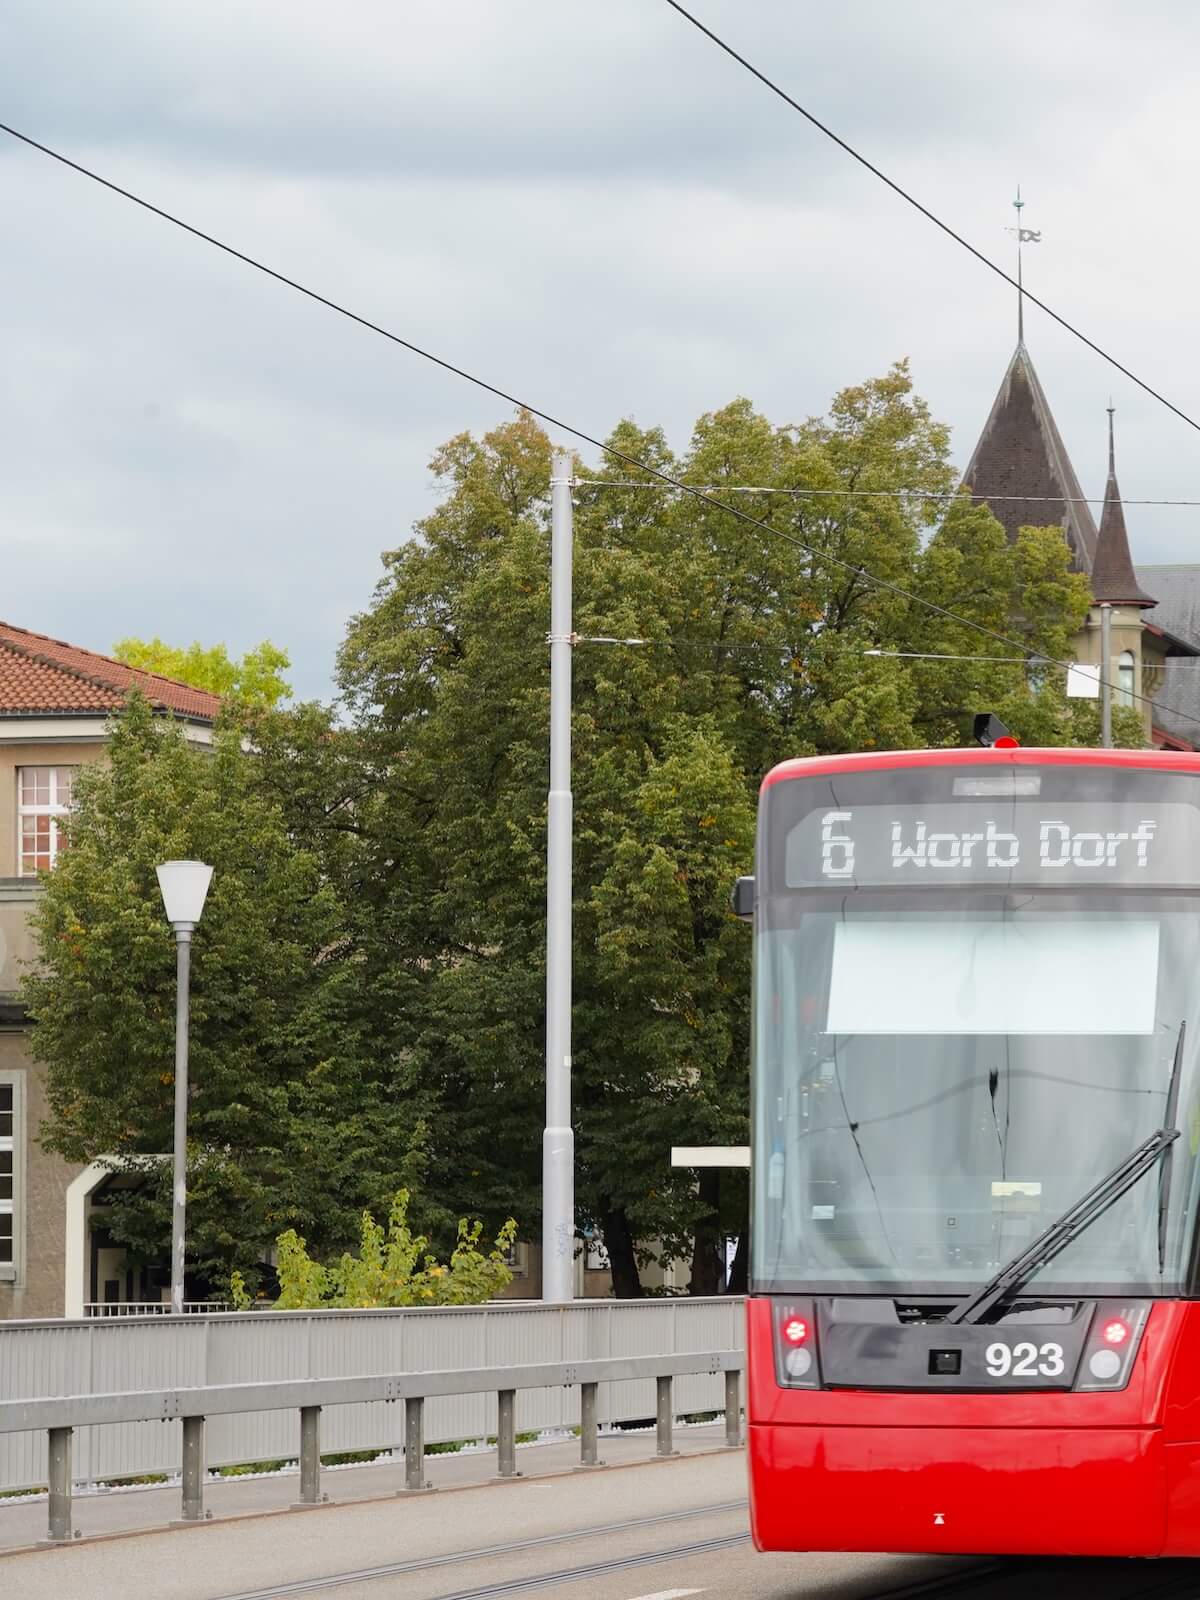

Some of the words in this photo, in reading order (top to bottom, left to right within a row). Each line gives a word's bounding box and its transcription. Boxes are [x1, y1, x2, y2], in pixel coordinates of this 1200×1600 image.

[822, 812, 855, 878] 6
[891, 821, 1020, 868] Worb
[1039, 820, 1158, 867] Dorf
[985, 1342, 1065, 1377] 923
